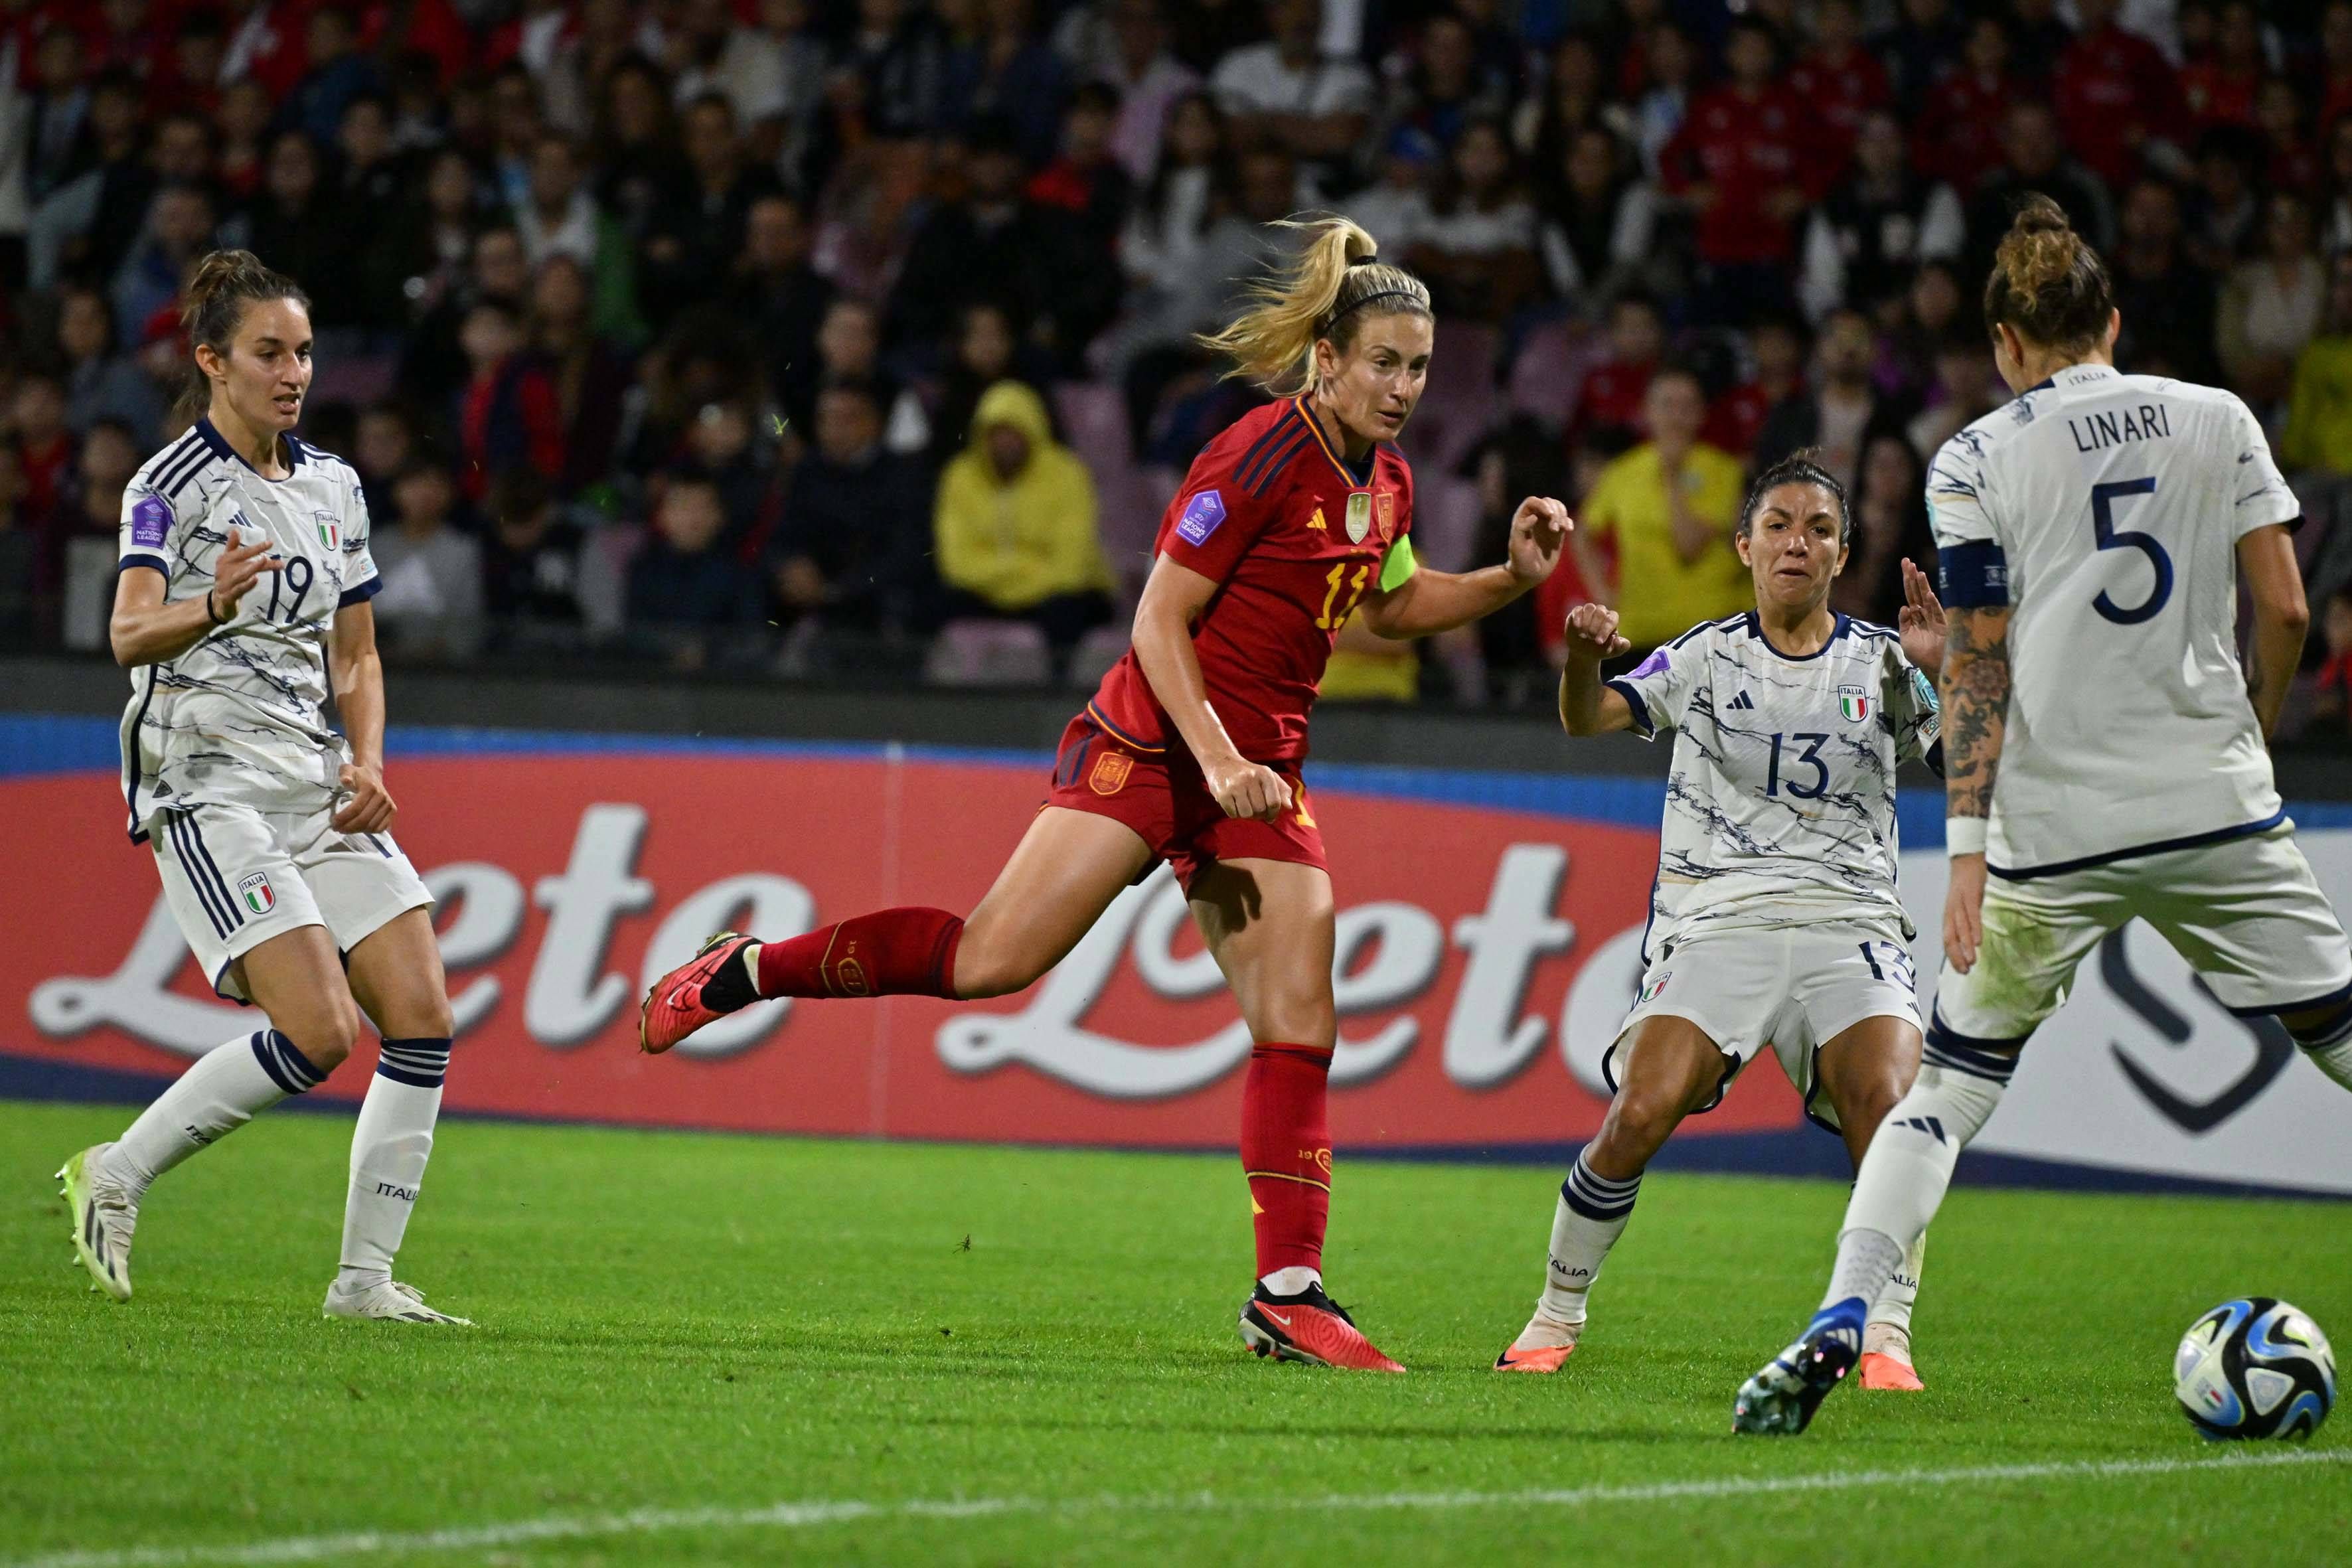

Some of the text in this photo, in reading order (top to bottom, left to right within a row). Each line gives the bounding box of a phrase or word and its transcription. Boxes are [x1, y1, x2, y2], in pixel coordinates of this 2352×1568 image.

[2069, 372, 2108, 386] ITALIA
[2068, 404, 2170, 452] LINARI
[1181, 522, 1202, 539] LEAGUE
[1183, 518, 1206, 536] NATIONS
[2092, 476, 2174, 625] 5
[267, 554, 313, 624] 19
[1314, 563, 1369, 629] 11
[1766, 732, 1831, 799] 13
[240, 875, 265, 890] ITALIA
